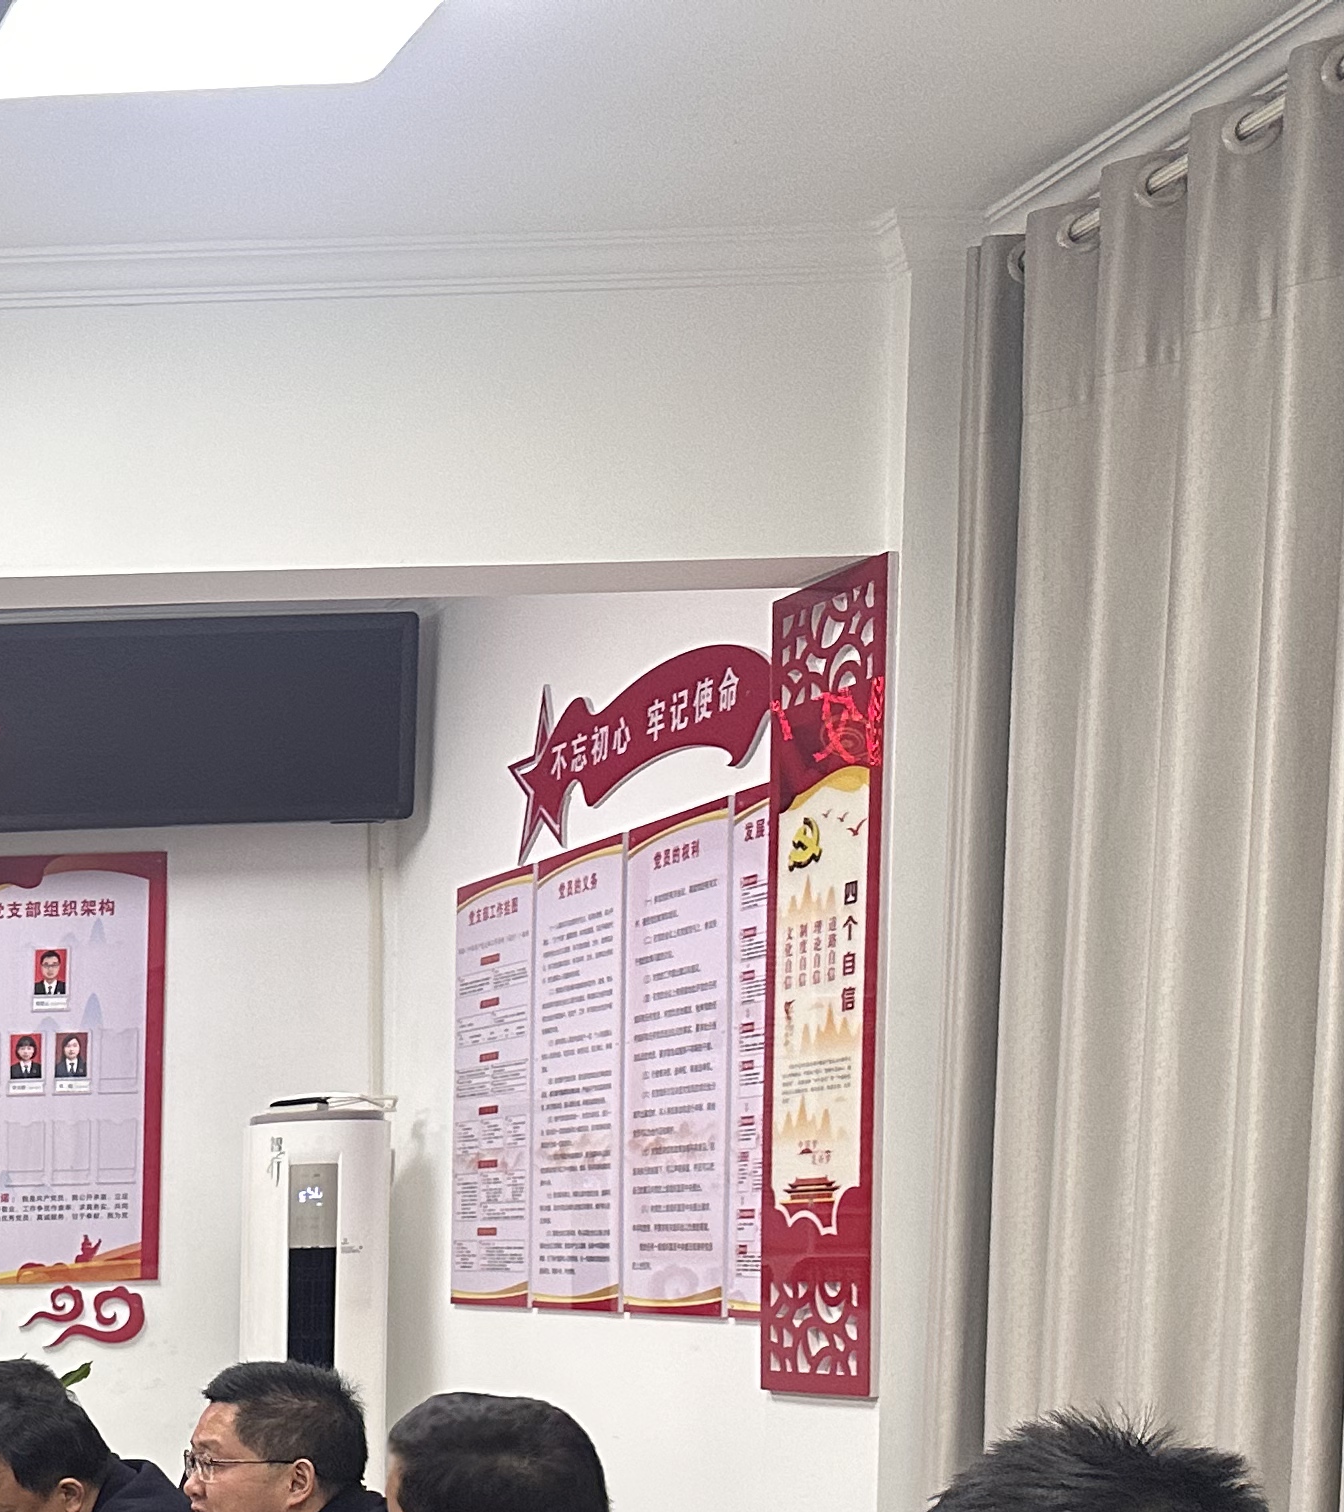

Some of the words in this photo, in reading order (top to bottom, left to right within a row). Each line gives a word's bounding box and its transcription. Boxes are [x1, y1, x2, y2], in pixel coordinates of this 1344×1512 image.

[550, 716, 632, 780] 不忘初心
[646, 666, 740, 742] 牢记使命
[653, 838, 700, 870] 党员的权利
[744, 818, 769, 842] 发展
[841, 880, 858, 1012] 四个自信
